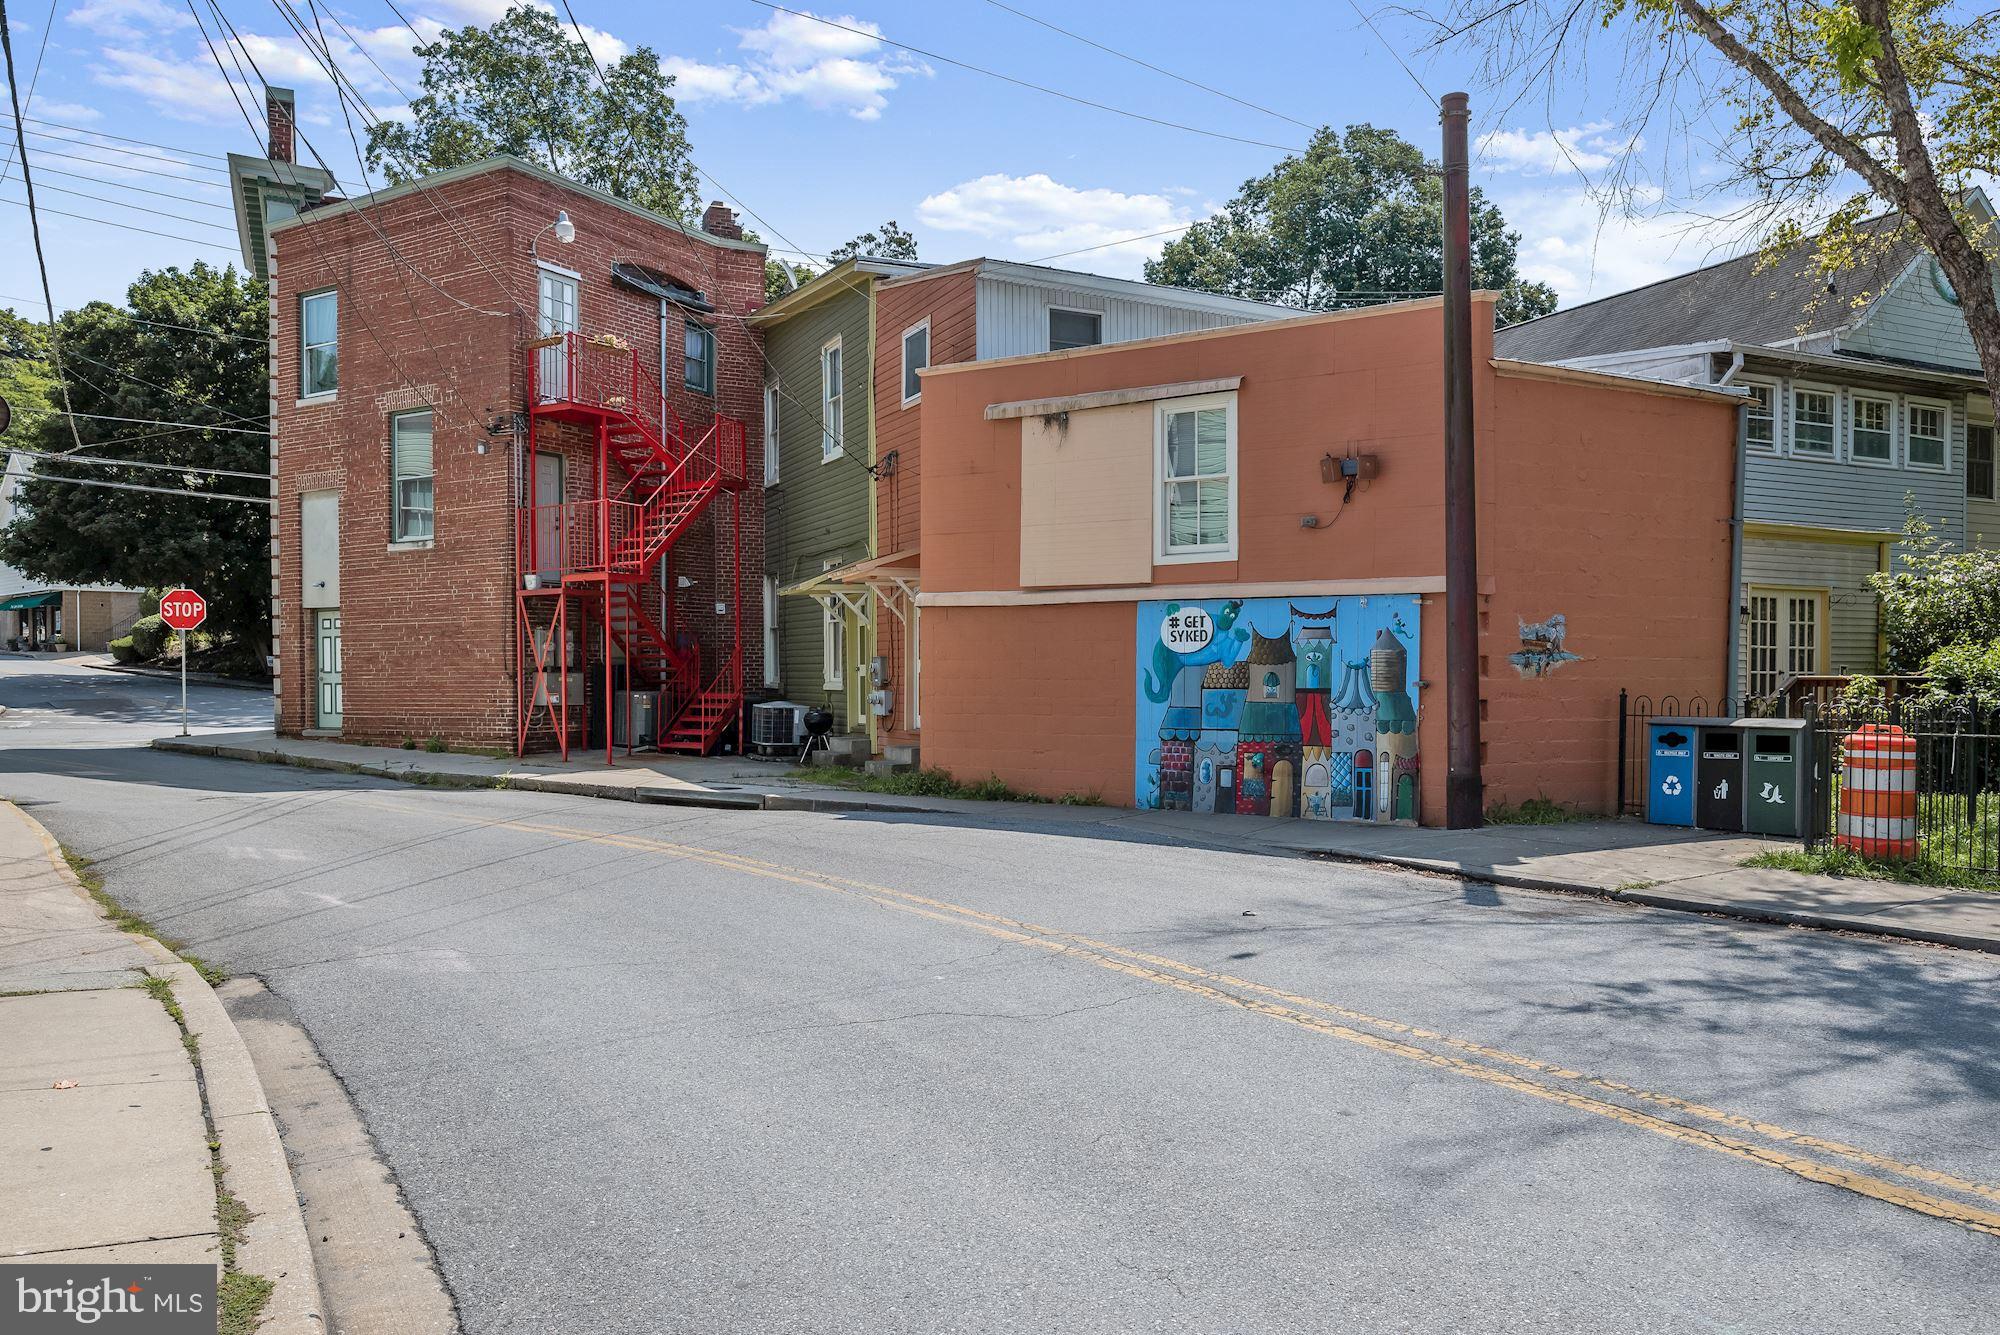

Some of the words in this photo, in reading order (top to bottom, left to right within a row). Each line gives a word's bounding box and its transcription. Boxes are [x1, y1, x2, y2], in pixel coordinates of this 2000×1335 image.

[163, 602, 203, 617] STOP
[1184, 615, 1206, 628] GET
[1170, 629, 1208, 642] SYKED
